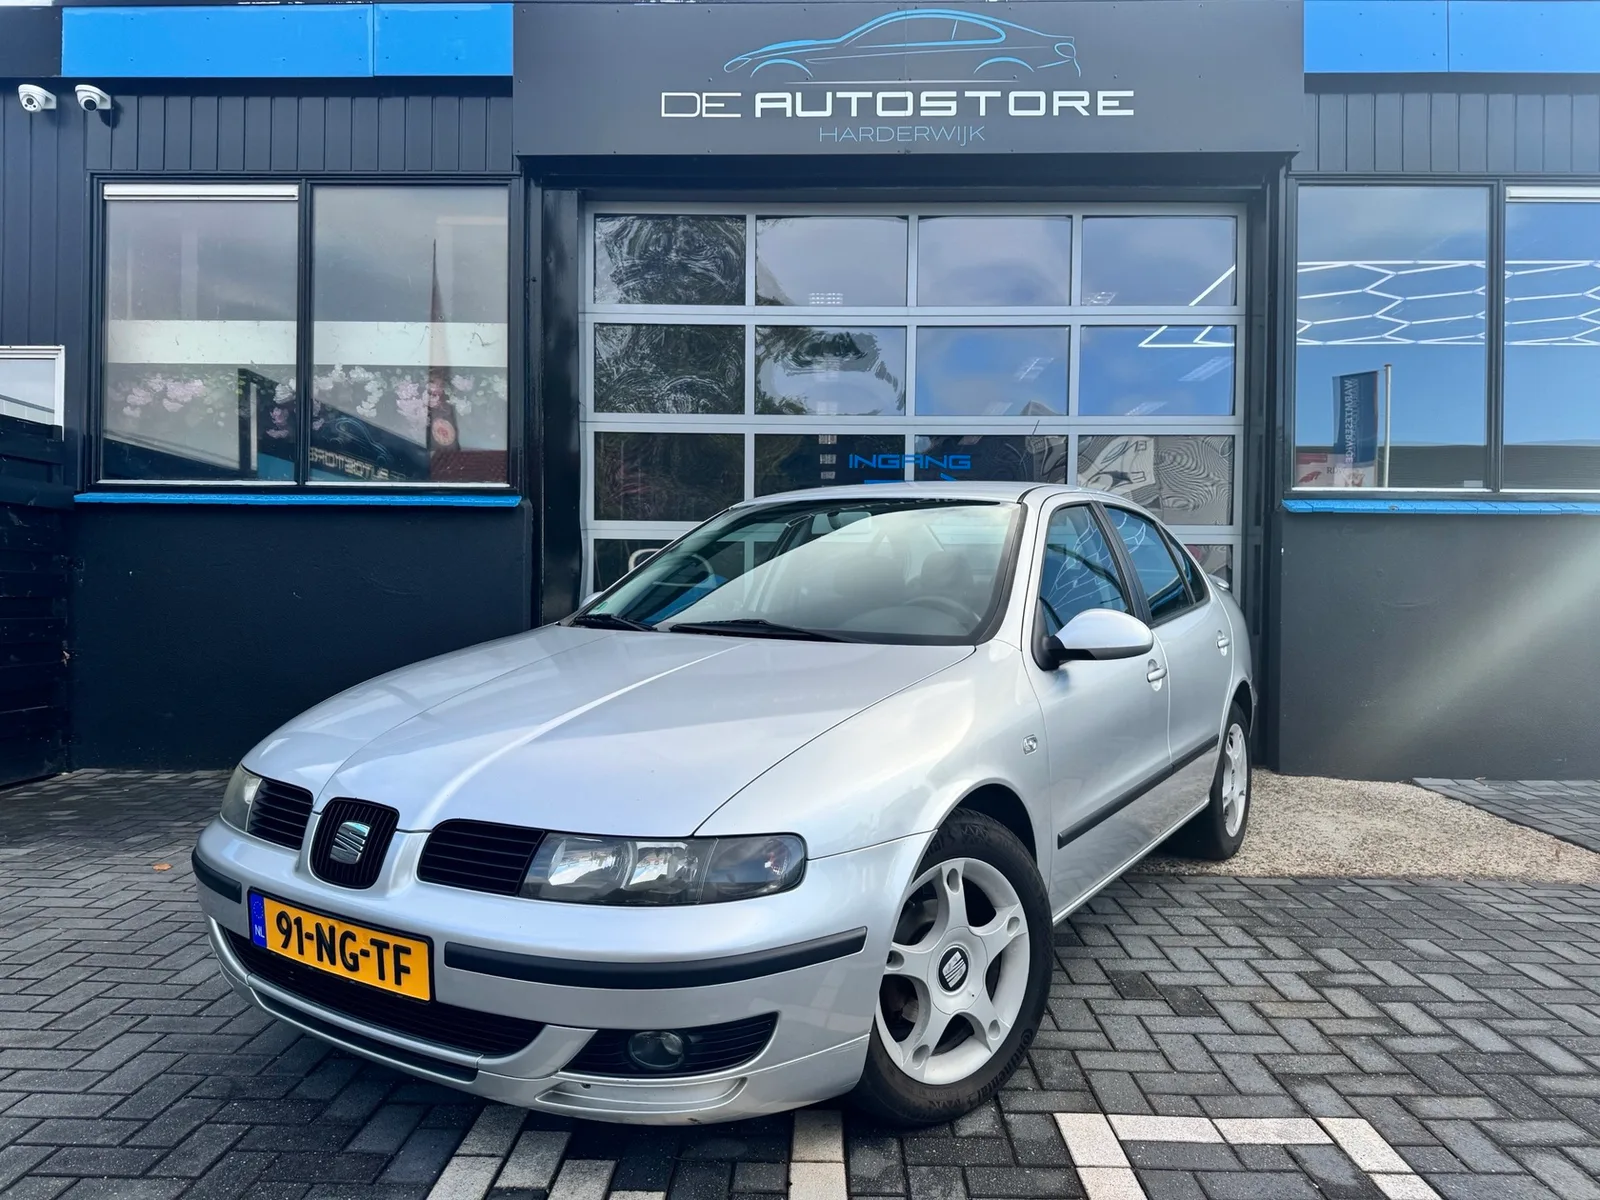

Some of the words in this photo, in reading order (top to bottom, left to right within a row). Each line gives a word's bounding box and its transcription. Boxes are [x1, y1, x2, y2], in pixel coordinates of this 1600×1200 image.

[660, 91, 742, 118] DE
[754, 90, 1135, 118] AUTOSTORE
[818, 125, 986, 147] HARDERWIJK
[848, 454, 972, 469] INGANG
[254, 924, 265, 938] NL
[275, 910, 412, 986] 91-NG-TF
